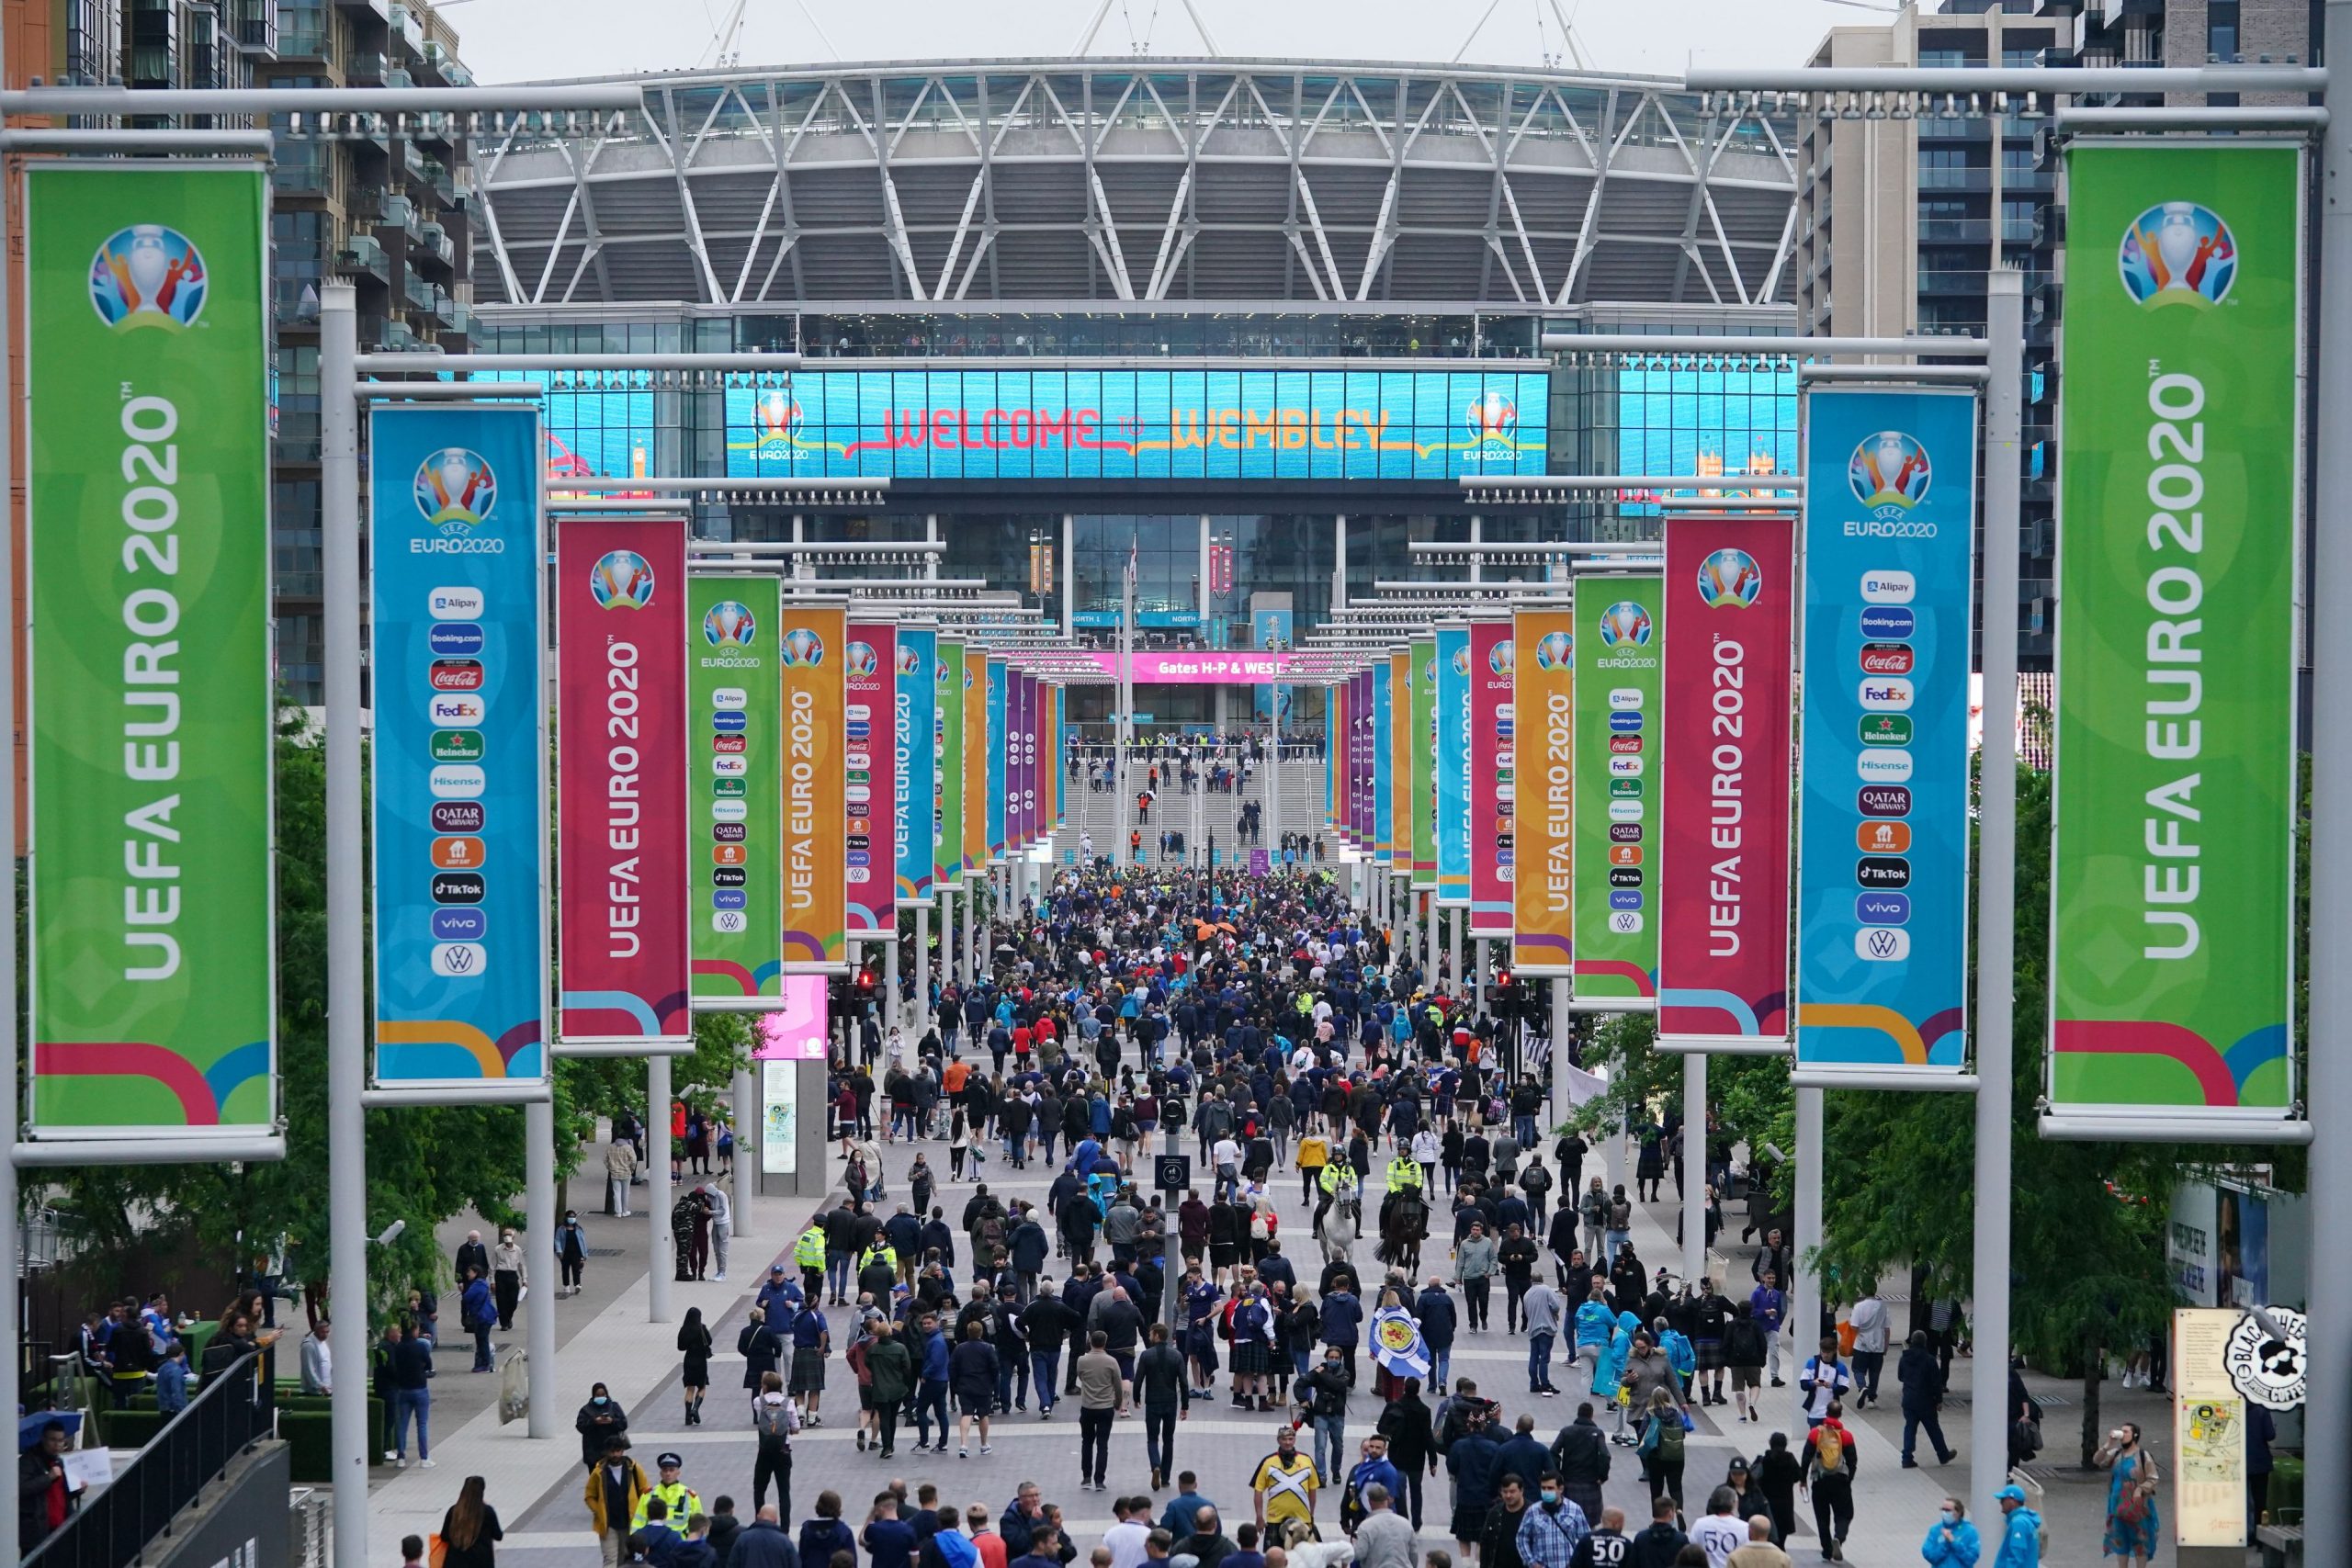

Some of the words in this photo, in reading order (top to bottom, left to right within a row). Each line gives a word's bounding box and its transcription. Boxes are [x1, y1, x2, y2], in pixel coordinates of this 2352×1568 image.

[883, 409, 1101, 449] WELCOME
[1118, 416, 1145, 436] TO
[1171, 409, 1389, 449] WEMBLEY
[749, 449, 809, 460] EURO2020
[1462, 449, 1523, 461] EURO2020
[1874, 507, 1904, 520] UEFA
[441, 524, 470, 536] UEFA
[1843, 521, 1938, 538] EURO2020
[410, 538, 504, 553] EURO2020
[1880, 581, 1909, 592] Alipay
[447, 598, 478, 609] Alipay
[1862, 617, 1912, 628] Booking.com
[431, 634, 481, 644] Booking.com
[701, 657, 761, 668] EURO2020
[1159, 661, 1198, 674] Gates
[1202, 661, 1227, 674] H-P
[1230, 661, 1241, 674] &
[1597, 658, 1657, 669] EURO2020
[2145, 566, 2203, 760] EURO
[121, 588, 181, 781] EURO
[1865, 687, 1906, 701] FedEx
[435, 704, 477, 716] FedEx
[1864, 731, 1907, 741] Heineken
[435, 747, 479, 757] Heineken
[716, 761, 742, 770] FedEx
[1612, 761, 1639, 770] FedEx
[1860, 761, 1909, 770] Hisense
[434, 777, 481, 785] Hisense
[608, 745, 639, 851] EURO
[791, 762, 813, 835] EURO
[1547, 766, 1569, 838] EURO
[1711, 743, 1743, 850] EURO
[1862, 792, 1905, 805] QATAR
[1872, 803, 1906, 811] AIRWAYS
[435, 807, 479, 821] QATAR
[447, 818, 480, 827] AIRWAYS
[2143, 773, 2201, 960] UEFA
[791, 839, 813, 908] UEFA
[1547, 841, 1569, 912] UEFA
[1871, 868, 1906, 879] TikTok
[123, 793, 181, 981] UEFA
[447, 884, 481, 895] TikTok
[609, 855, 640, 959] UEFA
[1709, 855, 1742, 957] UEFA
[1866, 902, 1901, 913] vivo
[441, 918, 476, 928] vivo
[2233, 1325, 2264, 1361] BLAC
[1703, 1530, 1738, 1554] 50
[1592, 1539, 1624, 1562] 50
